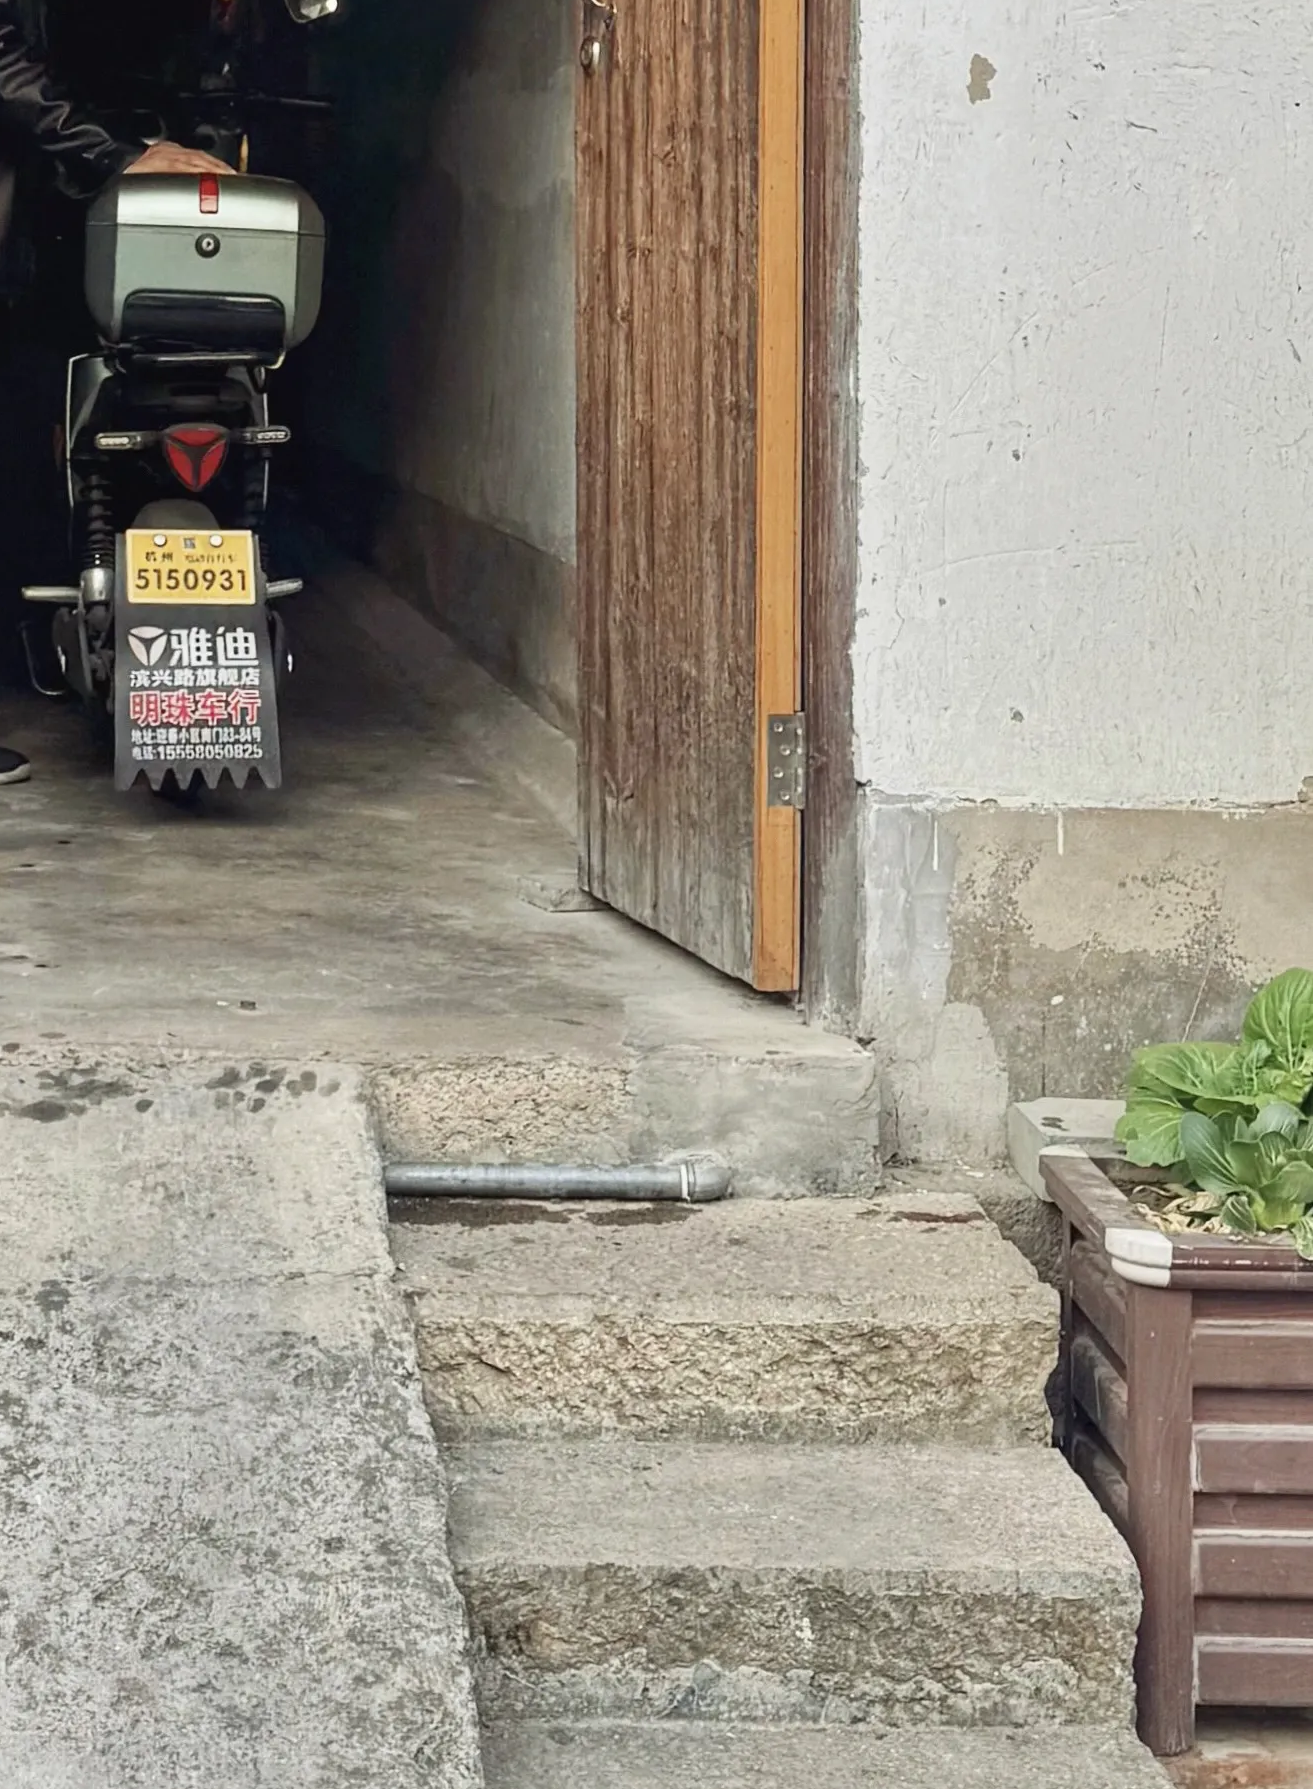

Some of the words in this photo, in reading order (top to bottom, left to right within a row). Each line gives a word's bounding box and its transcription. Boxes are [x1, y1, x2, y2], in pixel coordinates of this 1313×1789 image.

[135, 568, 247, 591] 5150931
[170, 626, 259, 667] 雅迪
[130, 688, 262, 726] 明珠车行
